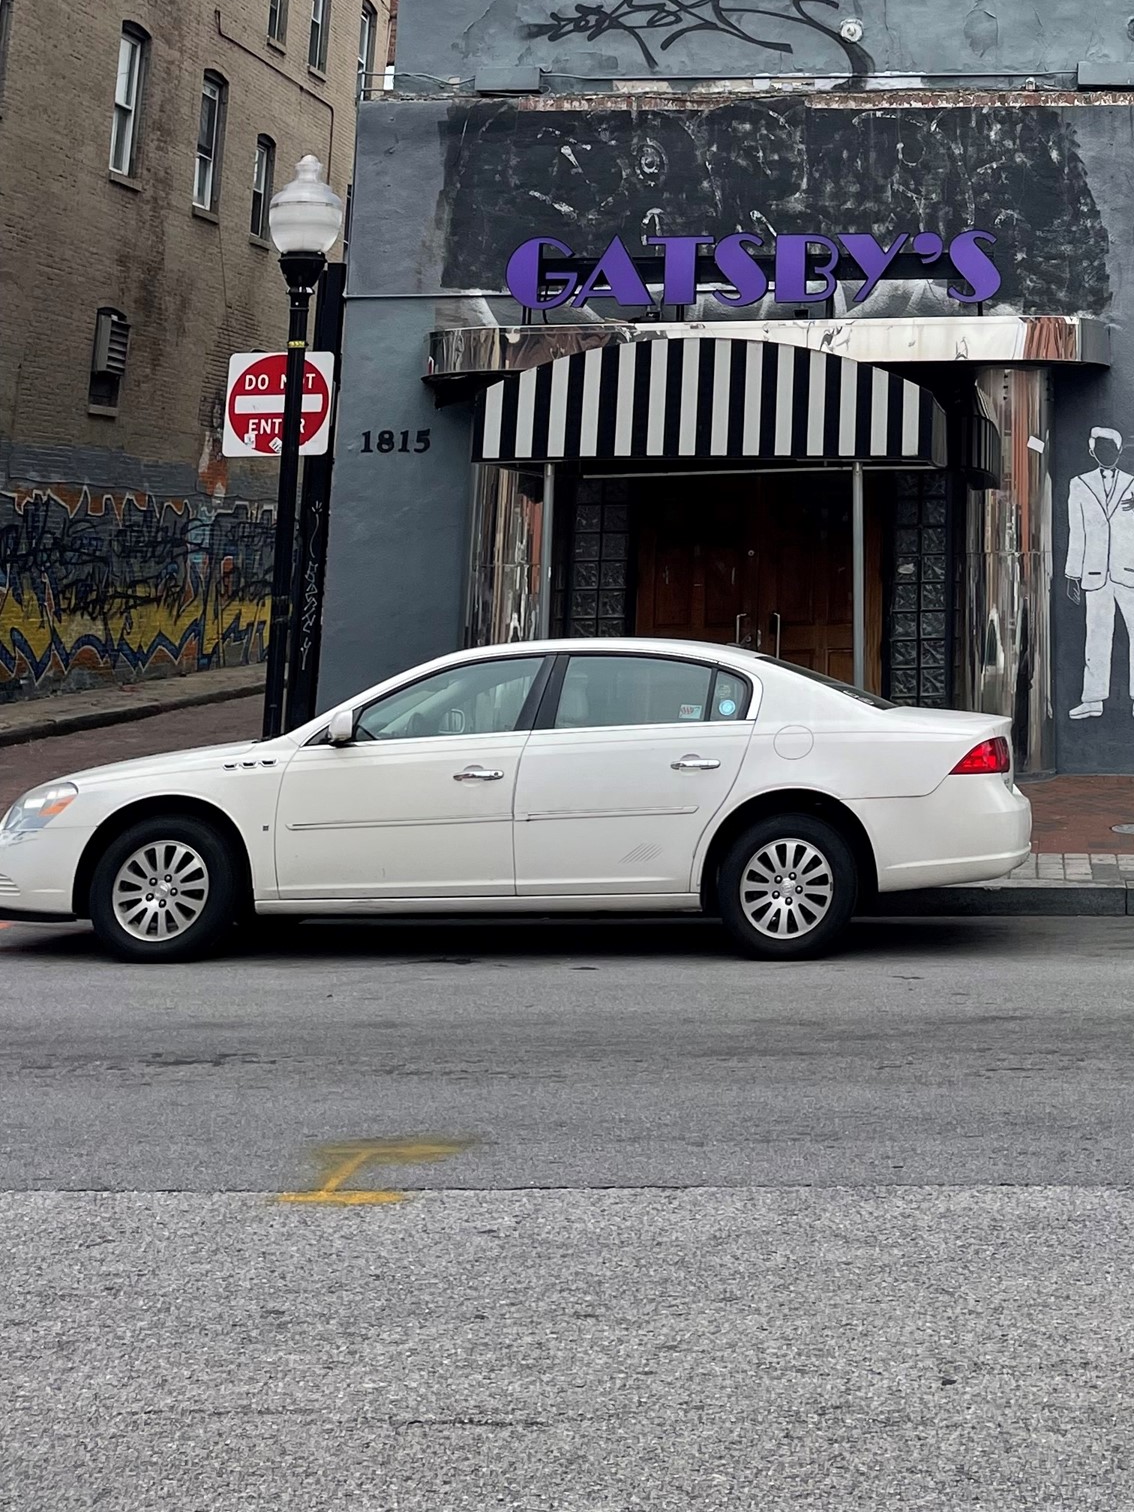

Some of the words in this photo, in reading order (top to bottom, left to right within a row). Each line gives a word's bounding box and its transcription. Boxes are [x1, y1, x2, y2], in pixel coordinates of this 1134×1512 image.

[505, 231, 1002, 310] GATSBY'S
[244, 374, 269, 390] DO
[280, 373, 316, 390] NT
[360, 428, 431, 453] 1815
